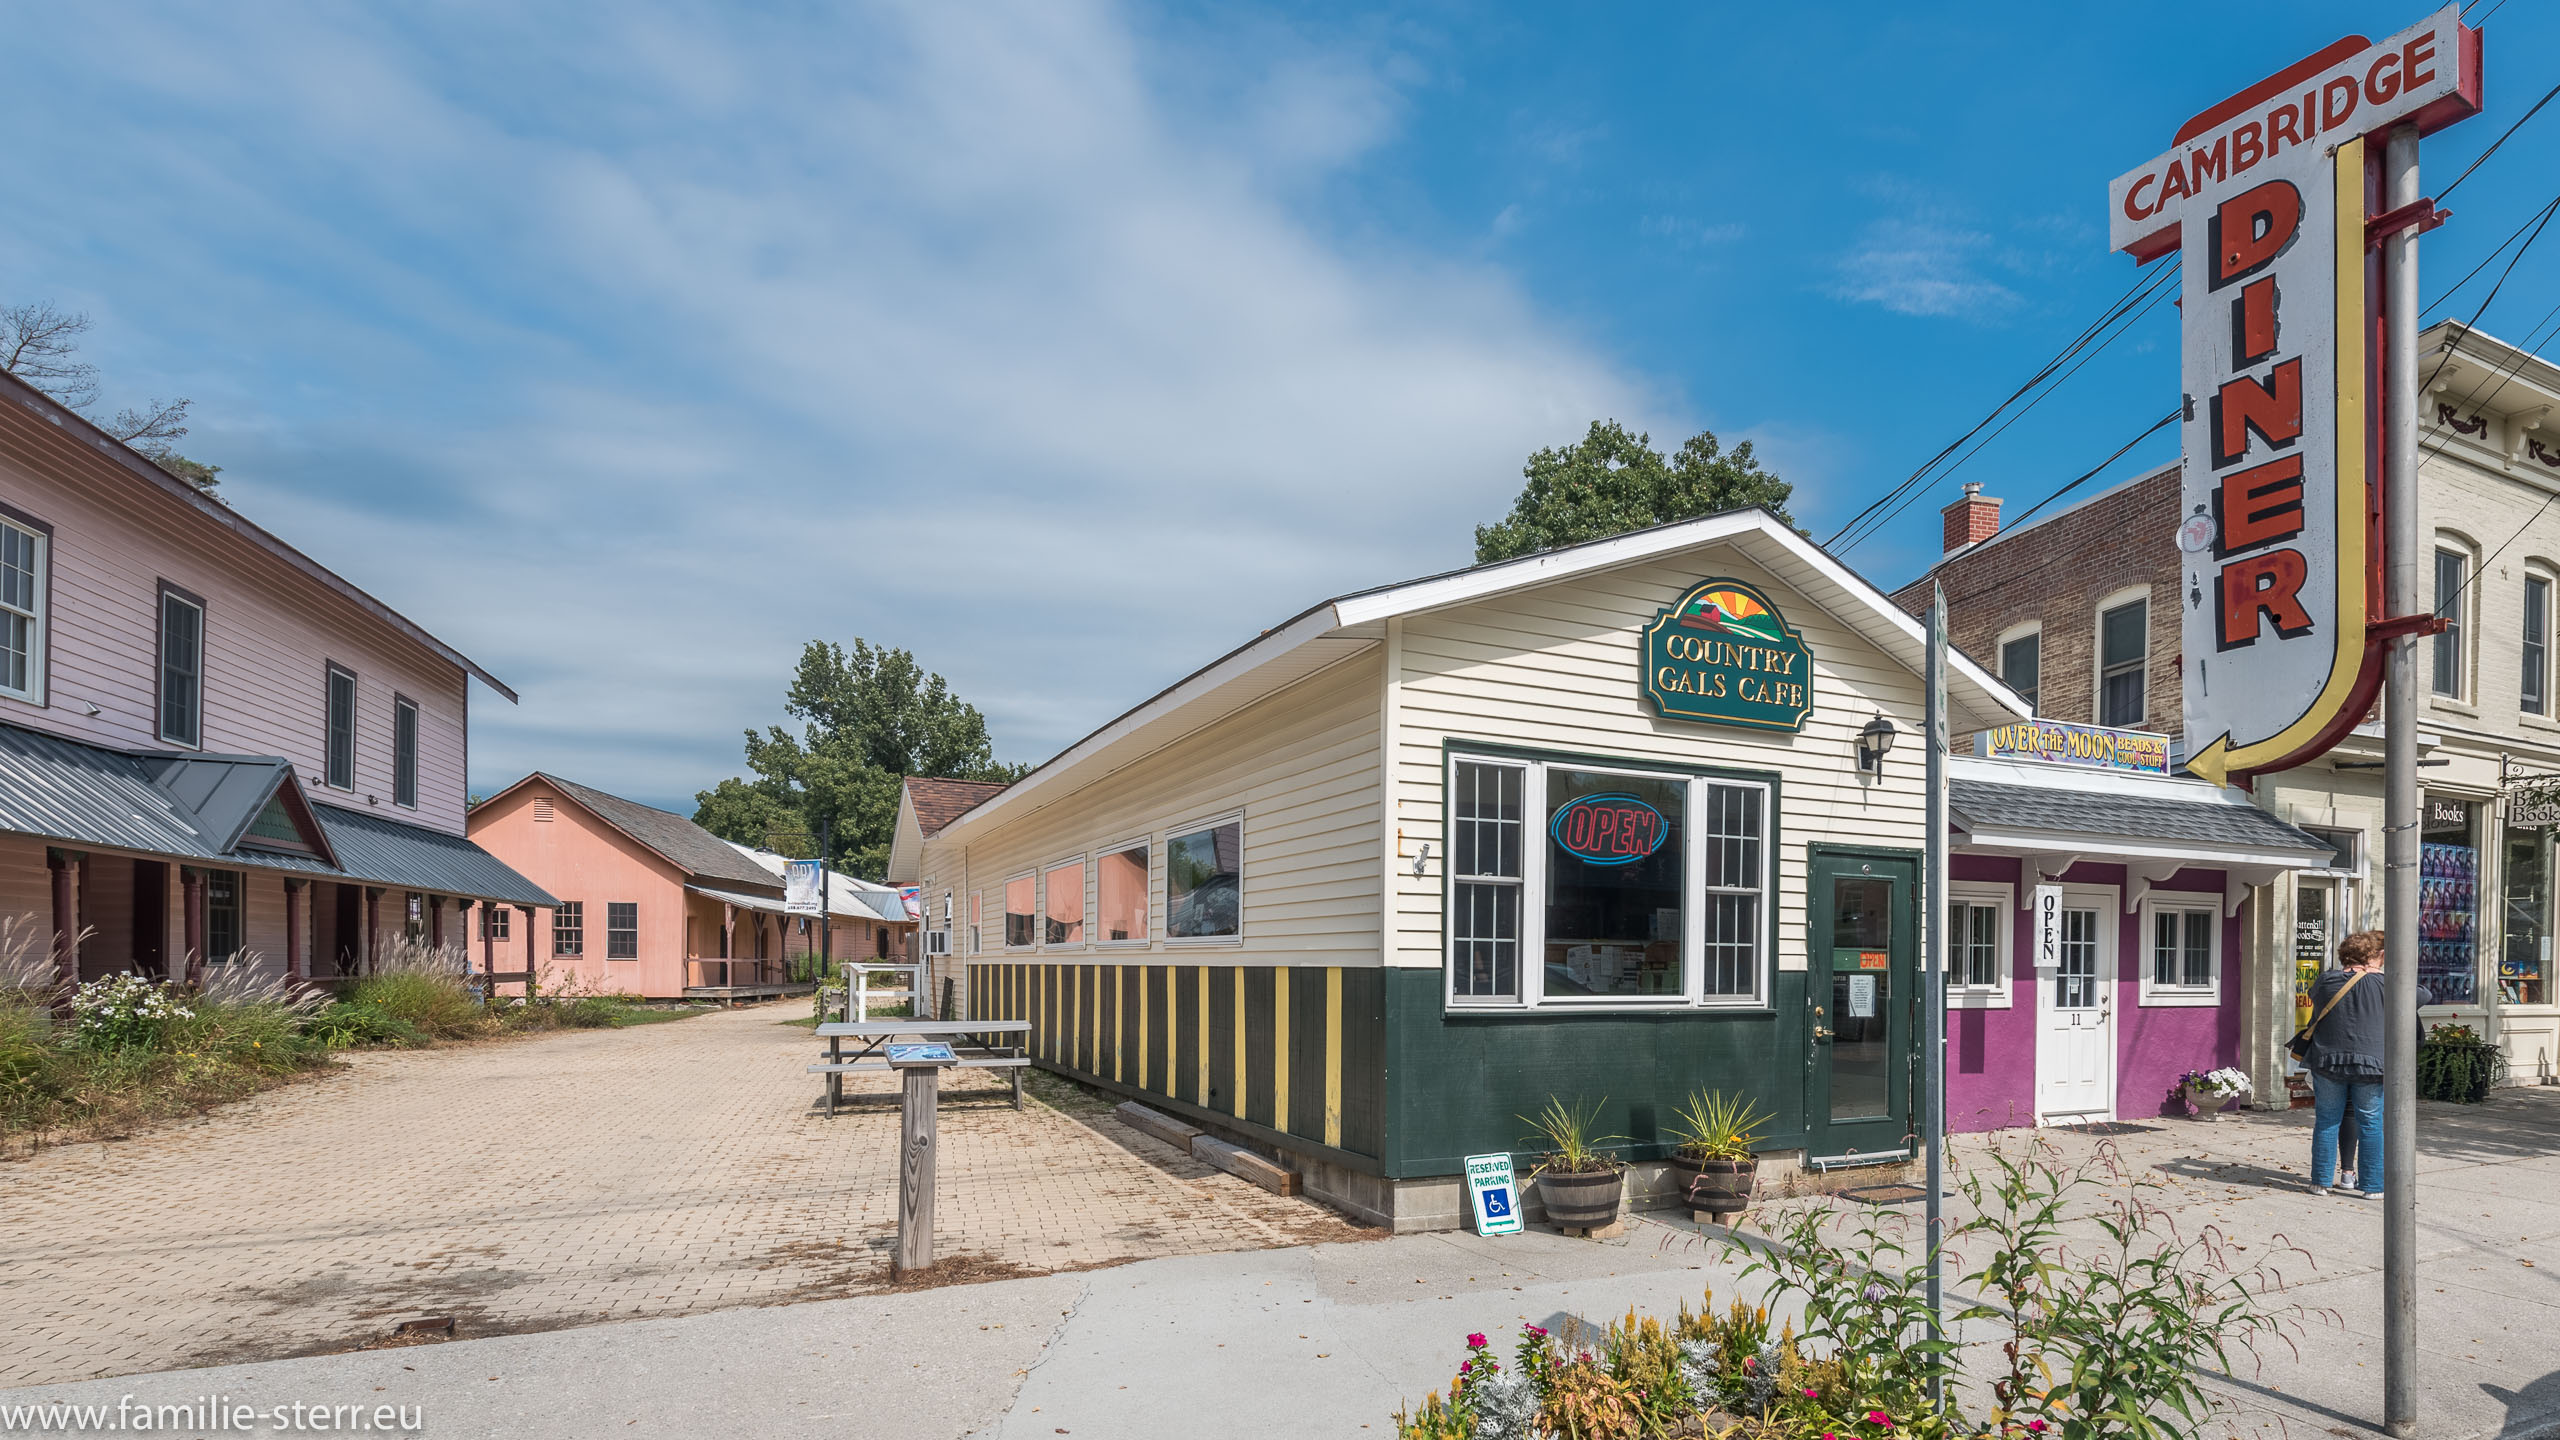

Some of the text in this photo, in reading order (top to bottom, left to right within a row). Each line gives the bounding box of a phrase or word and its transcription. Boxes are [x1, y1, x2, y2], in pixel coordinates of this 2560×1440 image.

[2124, 30, 2436, 221] CAMBRIDGE
[2208, 178, 2315, 653] DINER
[1666, 634, 1797, 676] COUNTRY
[1657, 666, 1803, 708] GALS CAFE
[1993, 725, 2116, 761] OVER THE MOON
[2117, 737, 2163, 754] BEADS &
[2117, 751, 2163, 767] COOL STUFF
[2435, 802, 2464, 822] Books
[1567, 806, 1656, 855] OPEN
[2043, 895, 2055, 960] OPEN
[2297, 919, 2323, 929] attenkill
[2296, 929, 2311, 940] ooks
[1860, 952, 1886, 969] OPEN
[2071, 1013, 2081, 1026] 11
[1469, 1162, 1509, 1174] RESERVED
[1475, 1175, 1510, 1187] PARKING
